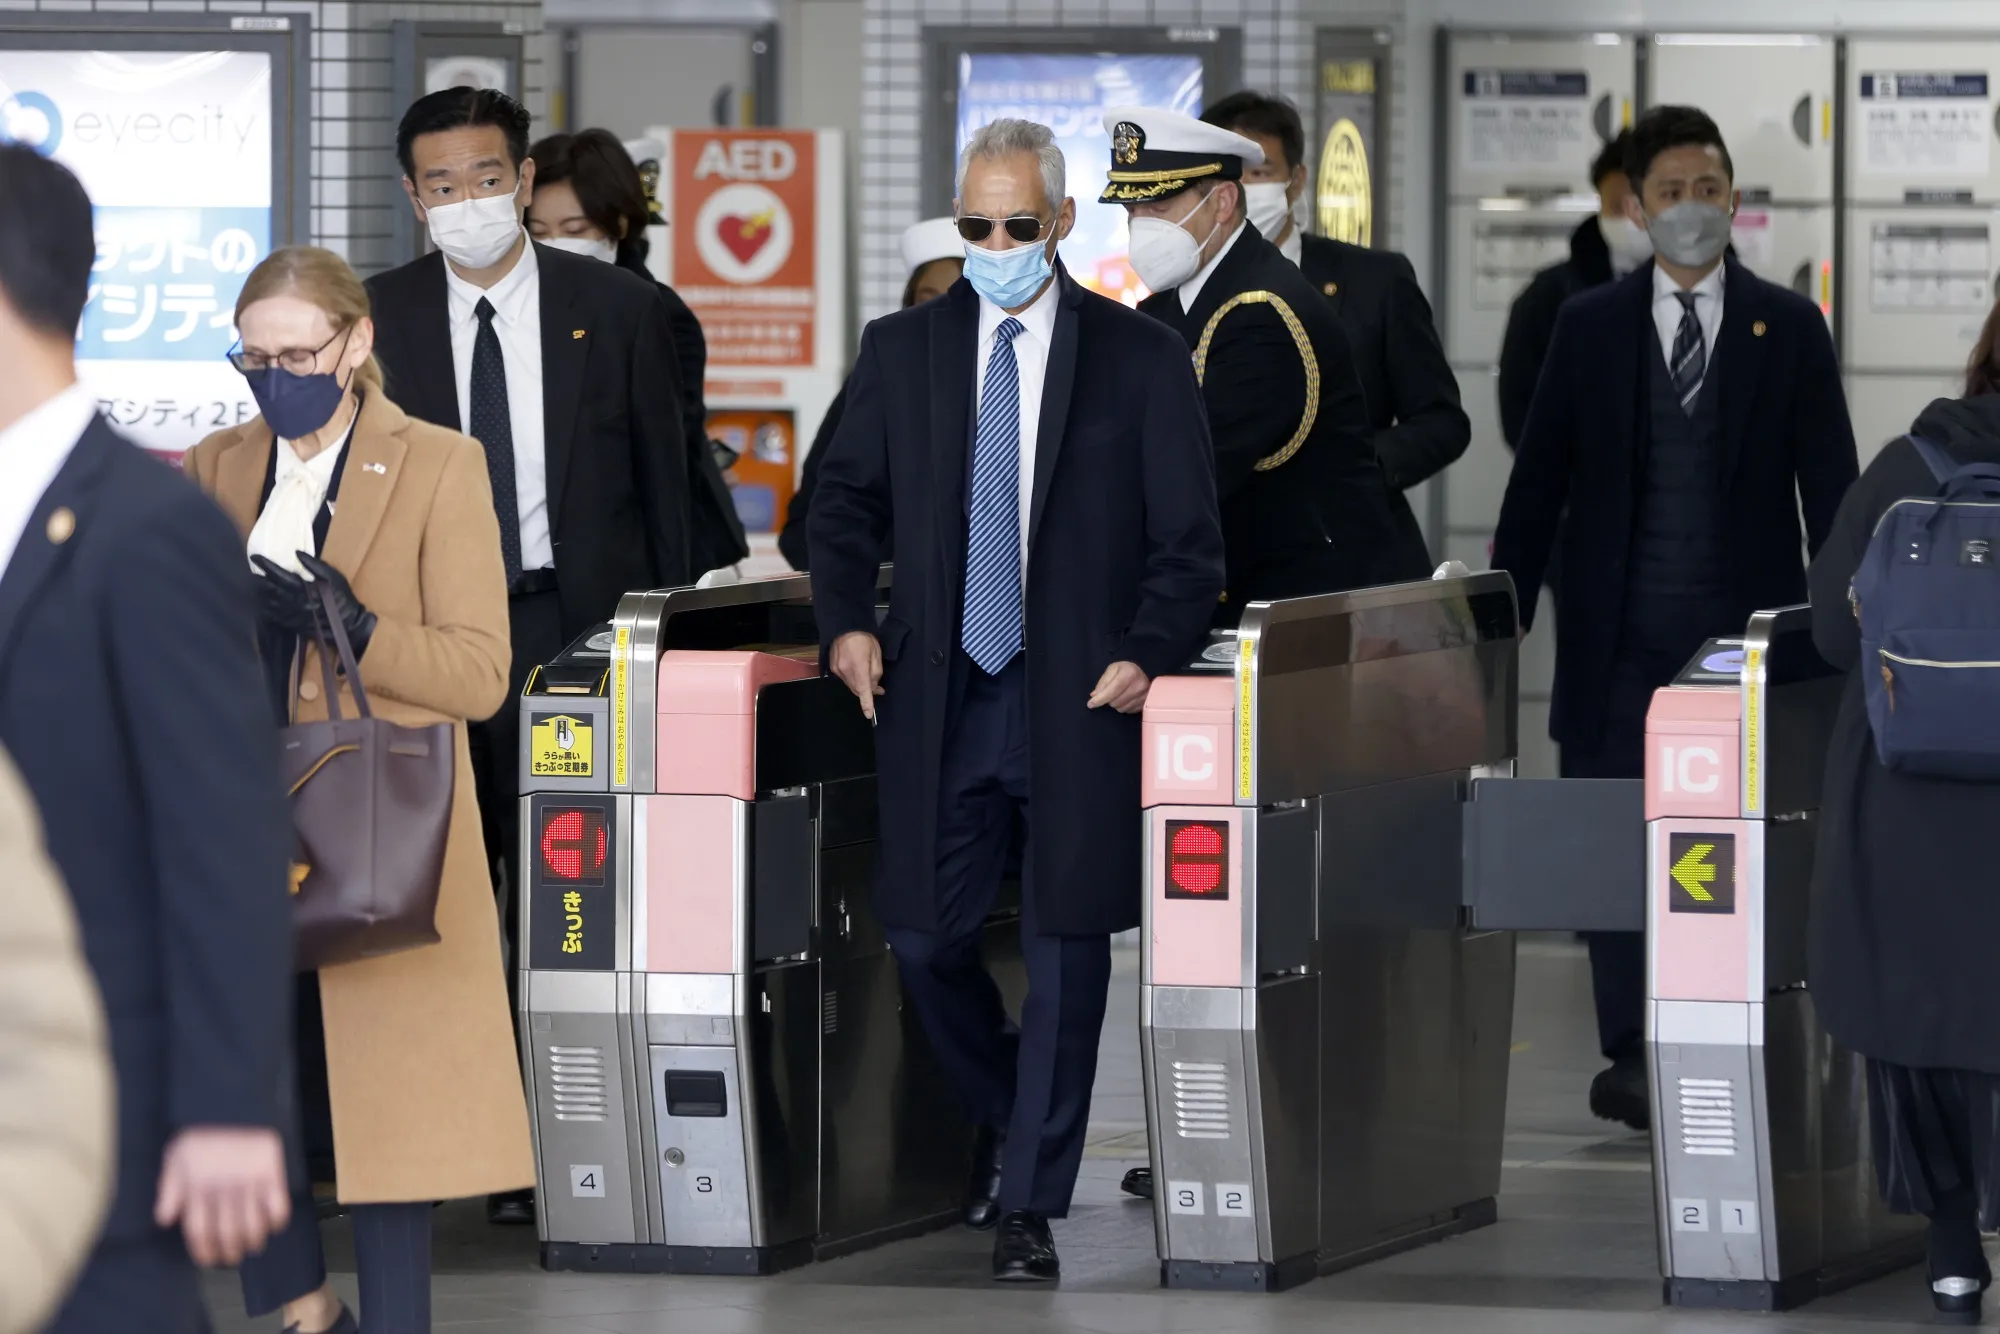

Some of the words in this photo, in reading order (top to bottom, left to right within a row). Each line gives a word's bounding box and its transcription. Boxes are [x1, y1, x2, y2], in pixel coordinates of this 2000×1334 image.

[74, 103, 257, 159] eyecity
[693, 139, 797, 181] AED
[1159, 734, 1213, 780] IC
[1663, 747, 1720, 793] IC
[562, 890, 583, 954] きっぷ
[580, 1173, 596, 1190] 4
[696, 1176, 713, 1193] 3
[1179, 1190, 1195, 1207] 3
[1226, 1192, 1243, 1209] 2
[1682, 1206, 1700, 1224] 2
[1734, 1208, 1743, 1226] 1
